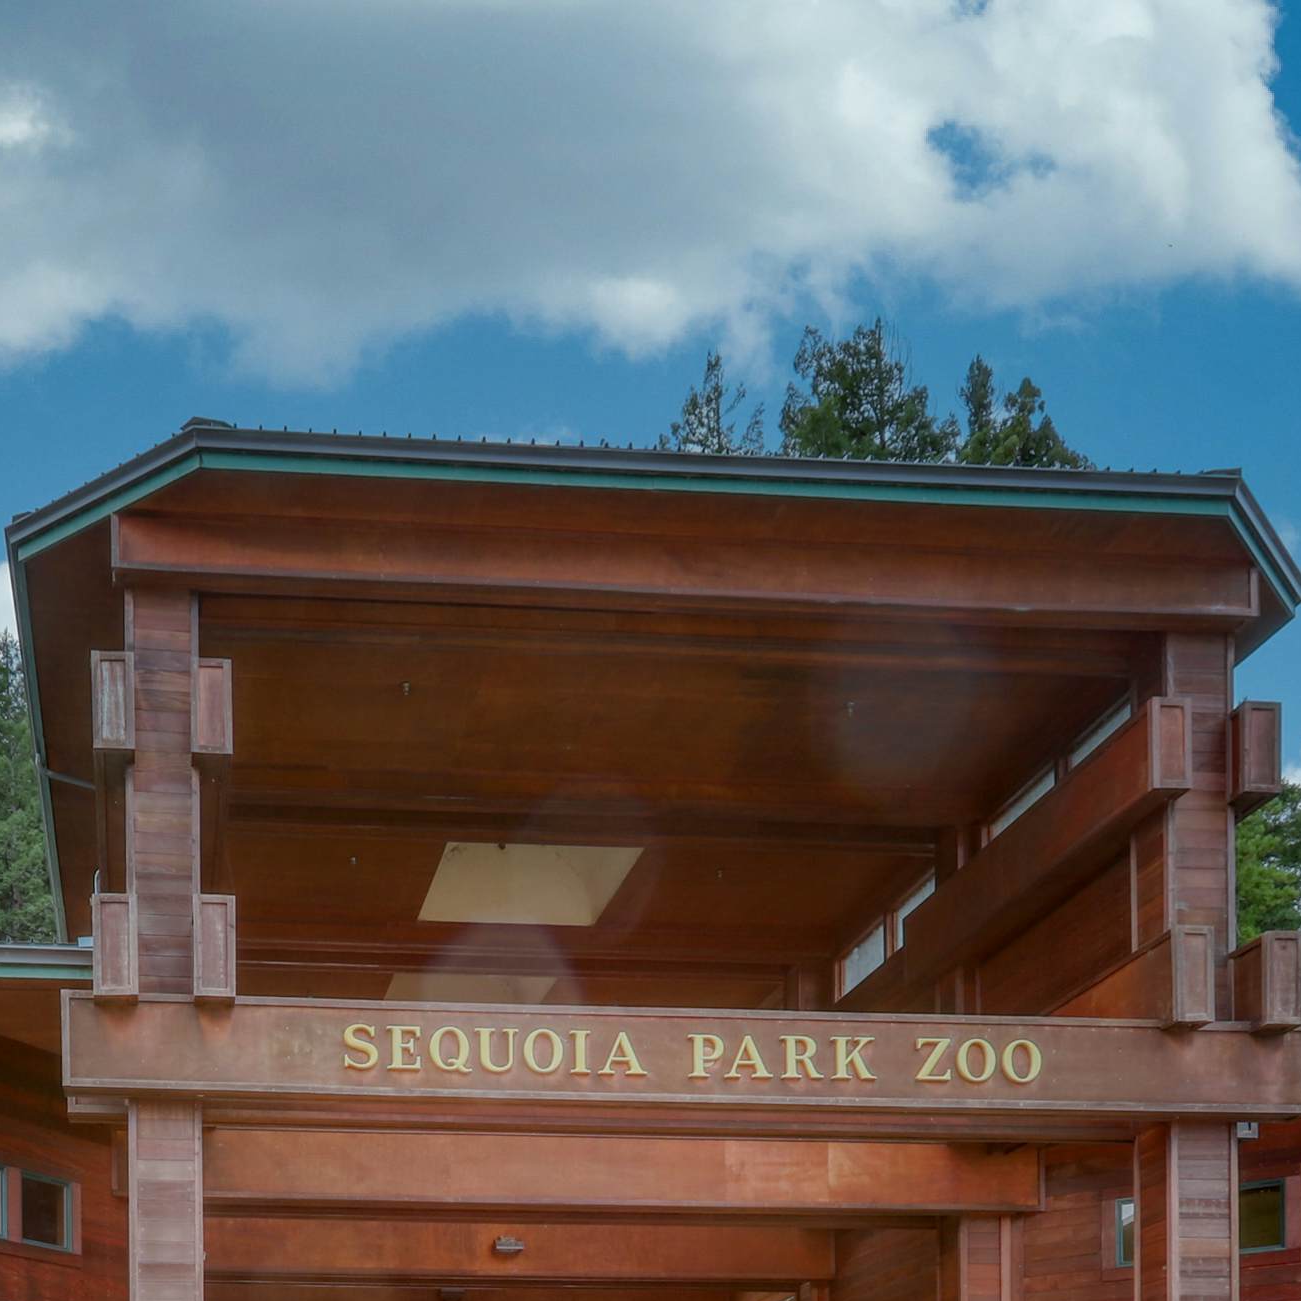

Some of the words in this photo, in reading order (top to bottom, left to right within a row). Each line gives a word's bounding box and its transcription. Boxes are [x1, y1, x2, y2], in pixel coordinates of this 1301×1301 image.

[343, 1023, 648, 1077] SEQUOIA
[688, 1032, 877, 1082] PARK
[915, 1036, 1043, 1084] ZOO
